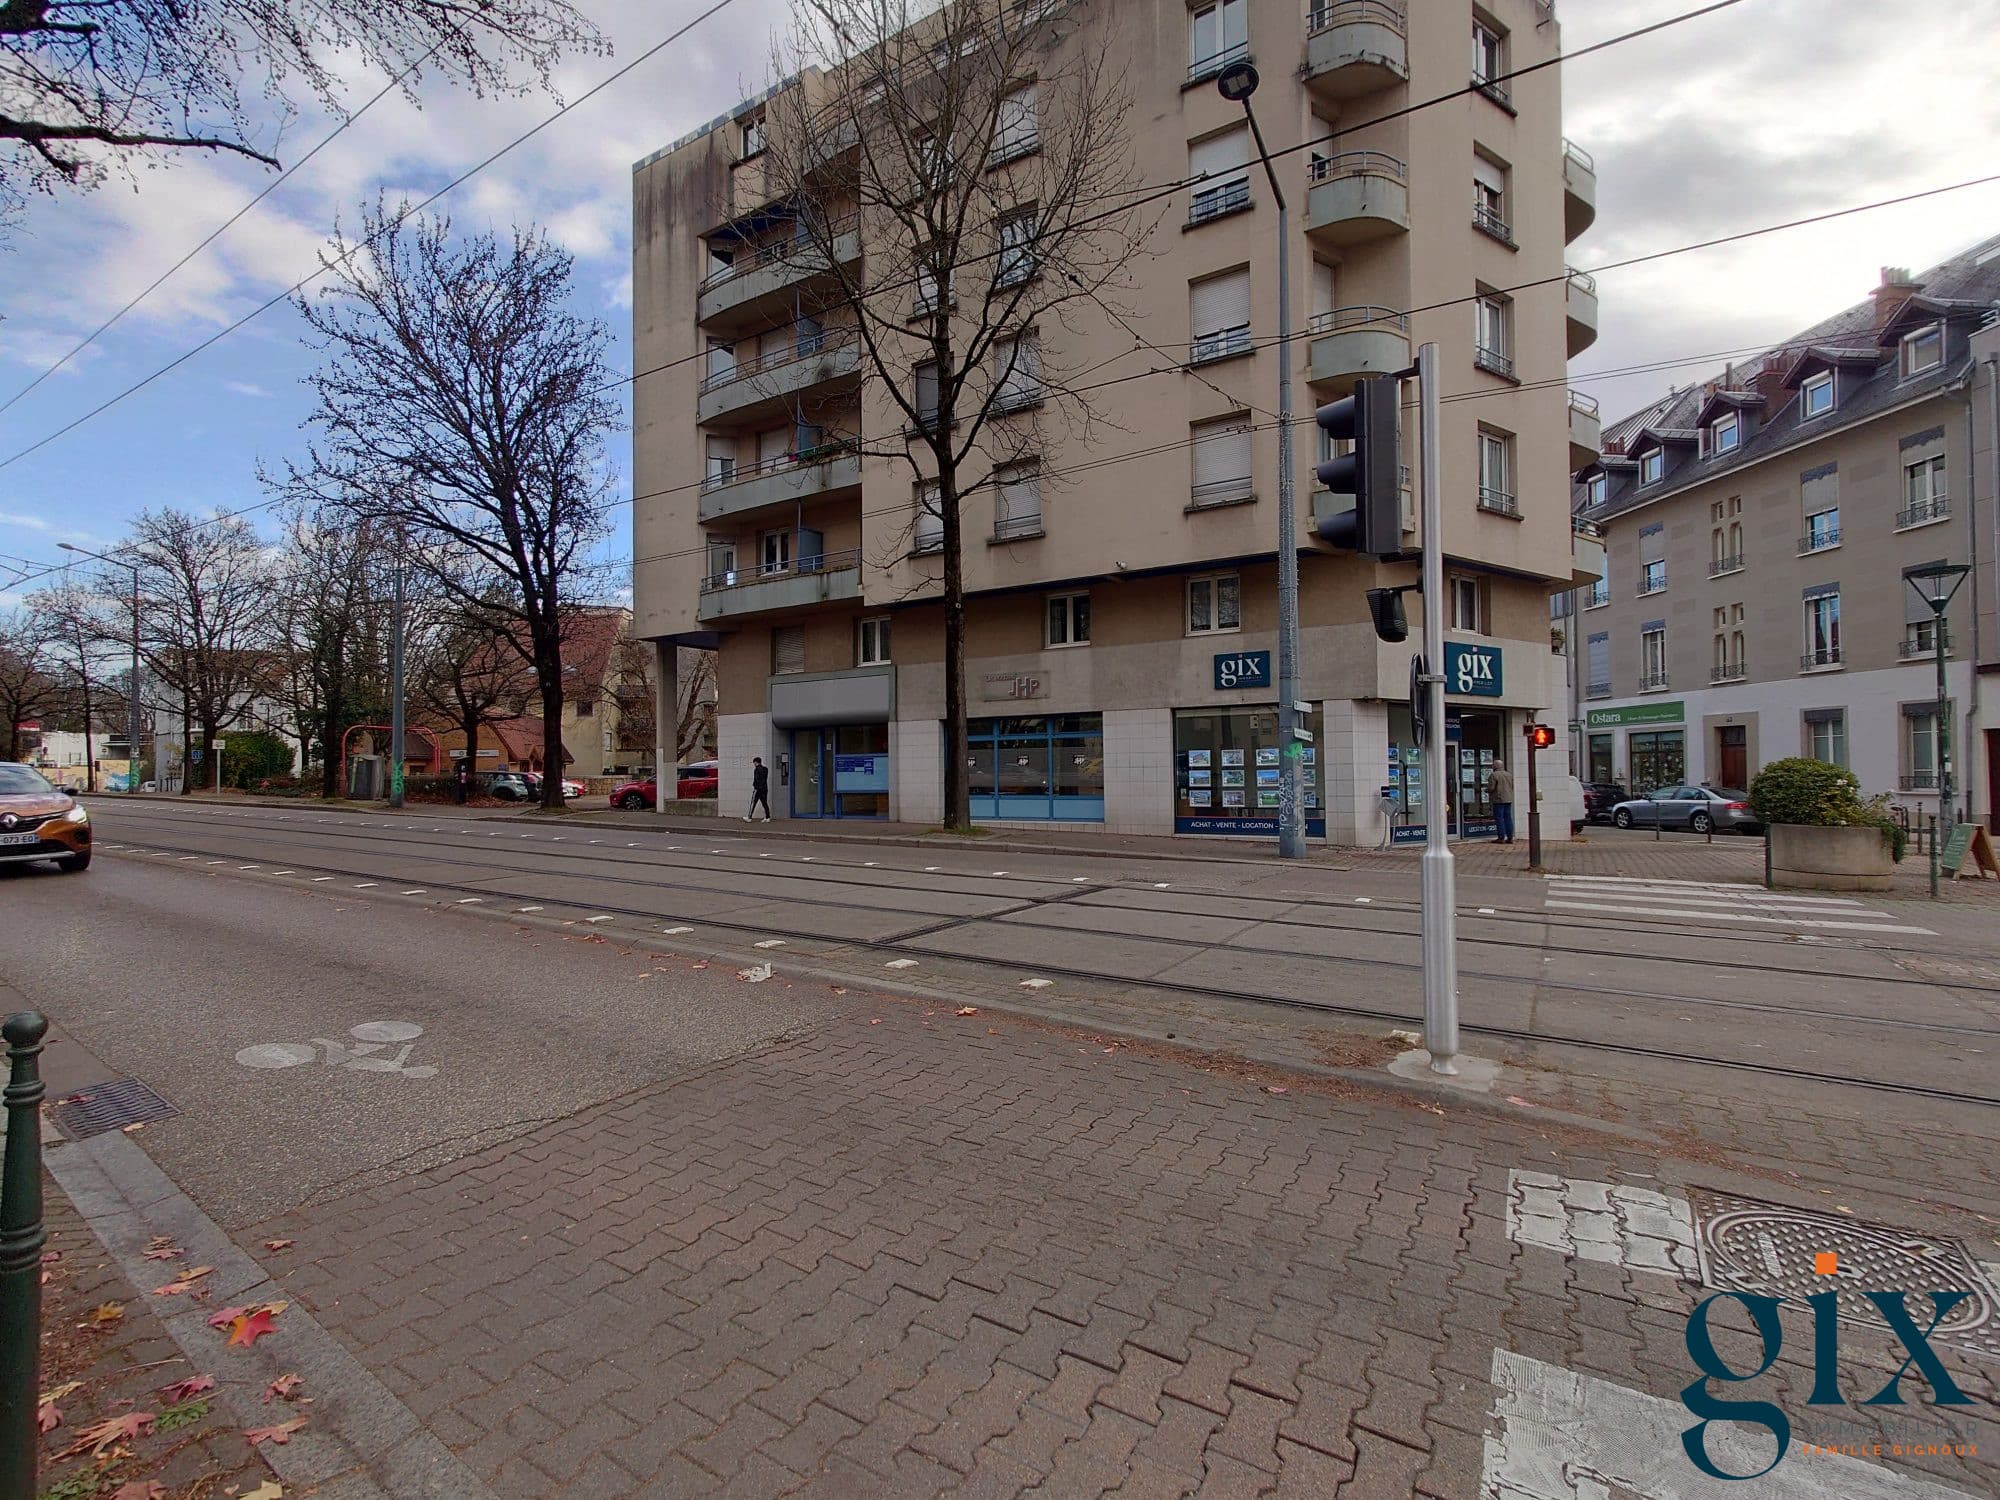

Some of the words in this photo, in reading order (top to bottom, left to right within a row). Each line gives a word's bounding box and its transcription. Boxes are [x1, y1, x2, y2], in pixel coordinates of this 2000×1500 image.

[1220, 654, 1262, 687] gix
[1457, 646, 1494, 693] gix
[1591, 713, 1621, 724] Ostara
